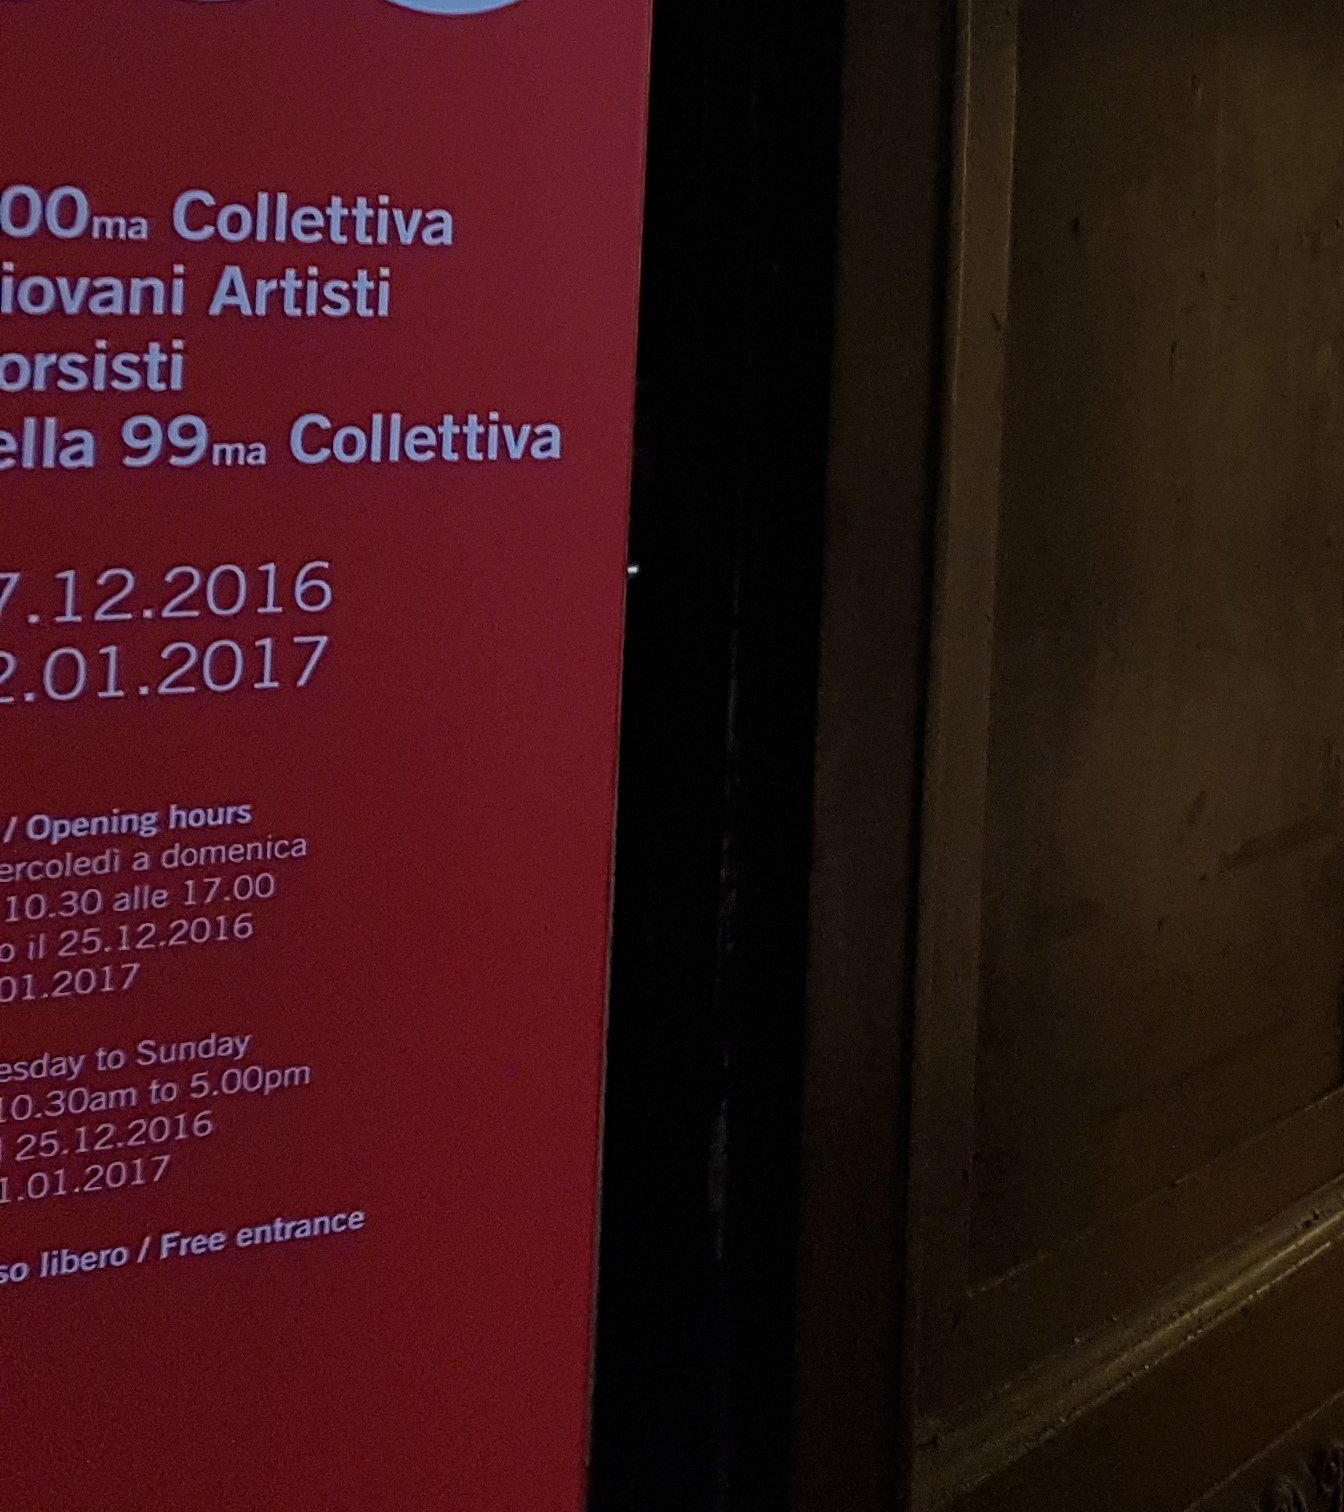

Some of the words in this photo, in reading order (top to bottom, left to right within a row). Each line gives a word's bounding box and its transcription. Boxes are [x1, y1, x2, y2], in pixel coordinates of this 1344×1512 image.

[173, 189, 455, 246] Collettiva
[0, 262, 185, 316] iovani
[209, 265, 393, 318] Artisti
[122, 414, 267, 468] 99ma
[290, 411, 562, 464] Collettiva
[26, 808, 160, 845] Opening
[169, 803, 253, 829] hours
[133, 851, 151, 872] a
[161, 834, 307, 870] domenica
[4, 888, 103, 923] 10.30
[113, 884, 169, 913] alle
[184, 872, 276, 906] 17.00
[27, 931, 47, 961] il
[57, 913, 254, 957] 25.12.2016
[96, 1046, 126, 1071] to
[136, 1032, 253, 1067] Sunday
[149, 1079, 178, 1105] to
[190, 1064, 312, 1100] 5.00pm
[14, 1109, 215, 1162] 25.12.2016
[39, 1246, 130, 1279] libero
[160, 1230, 228, 1261] Free
[236, 1210, 366, 1248] entrance
